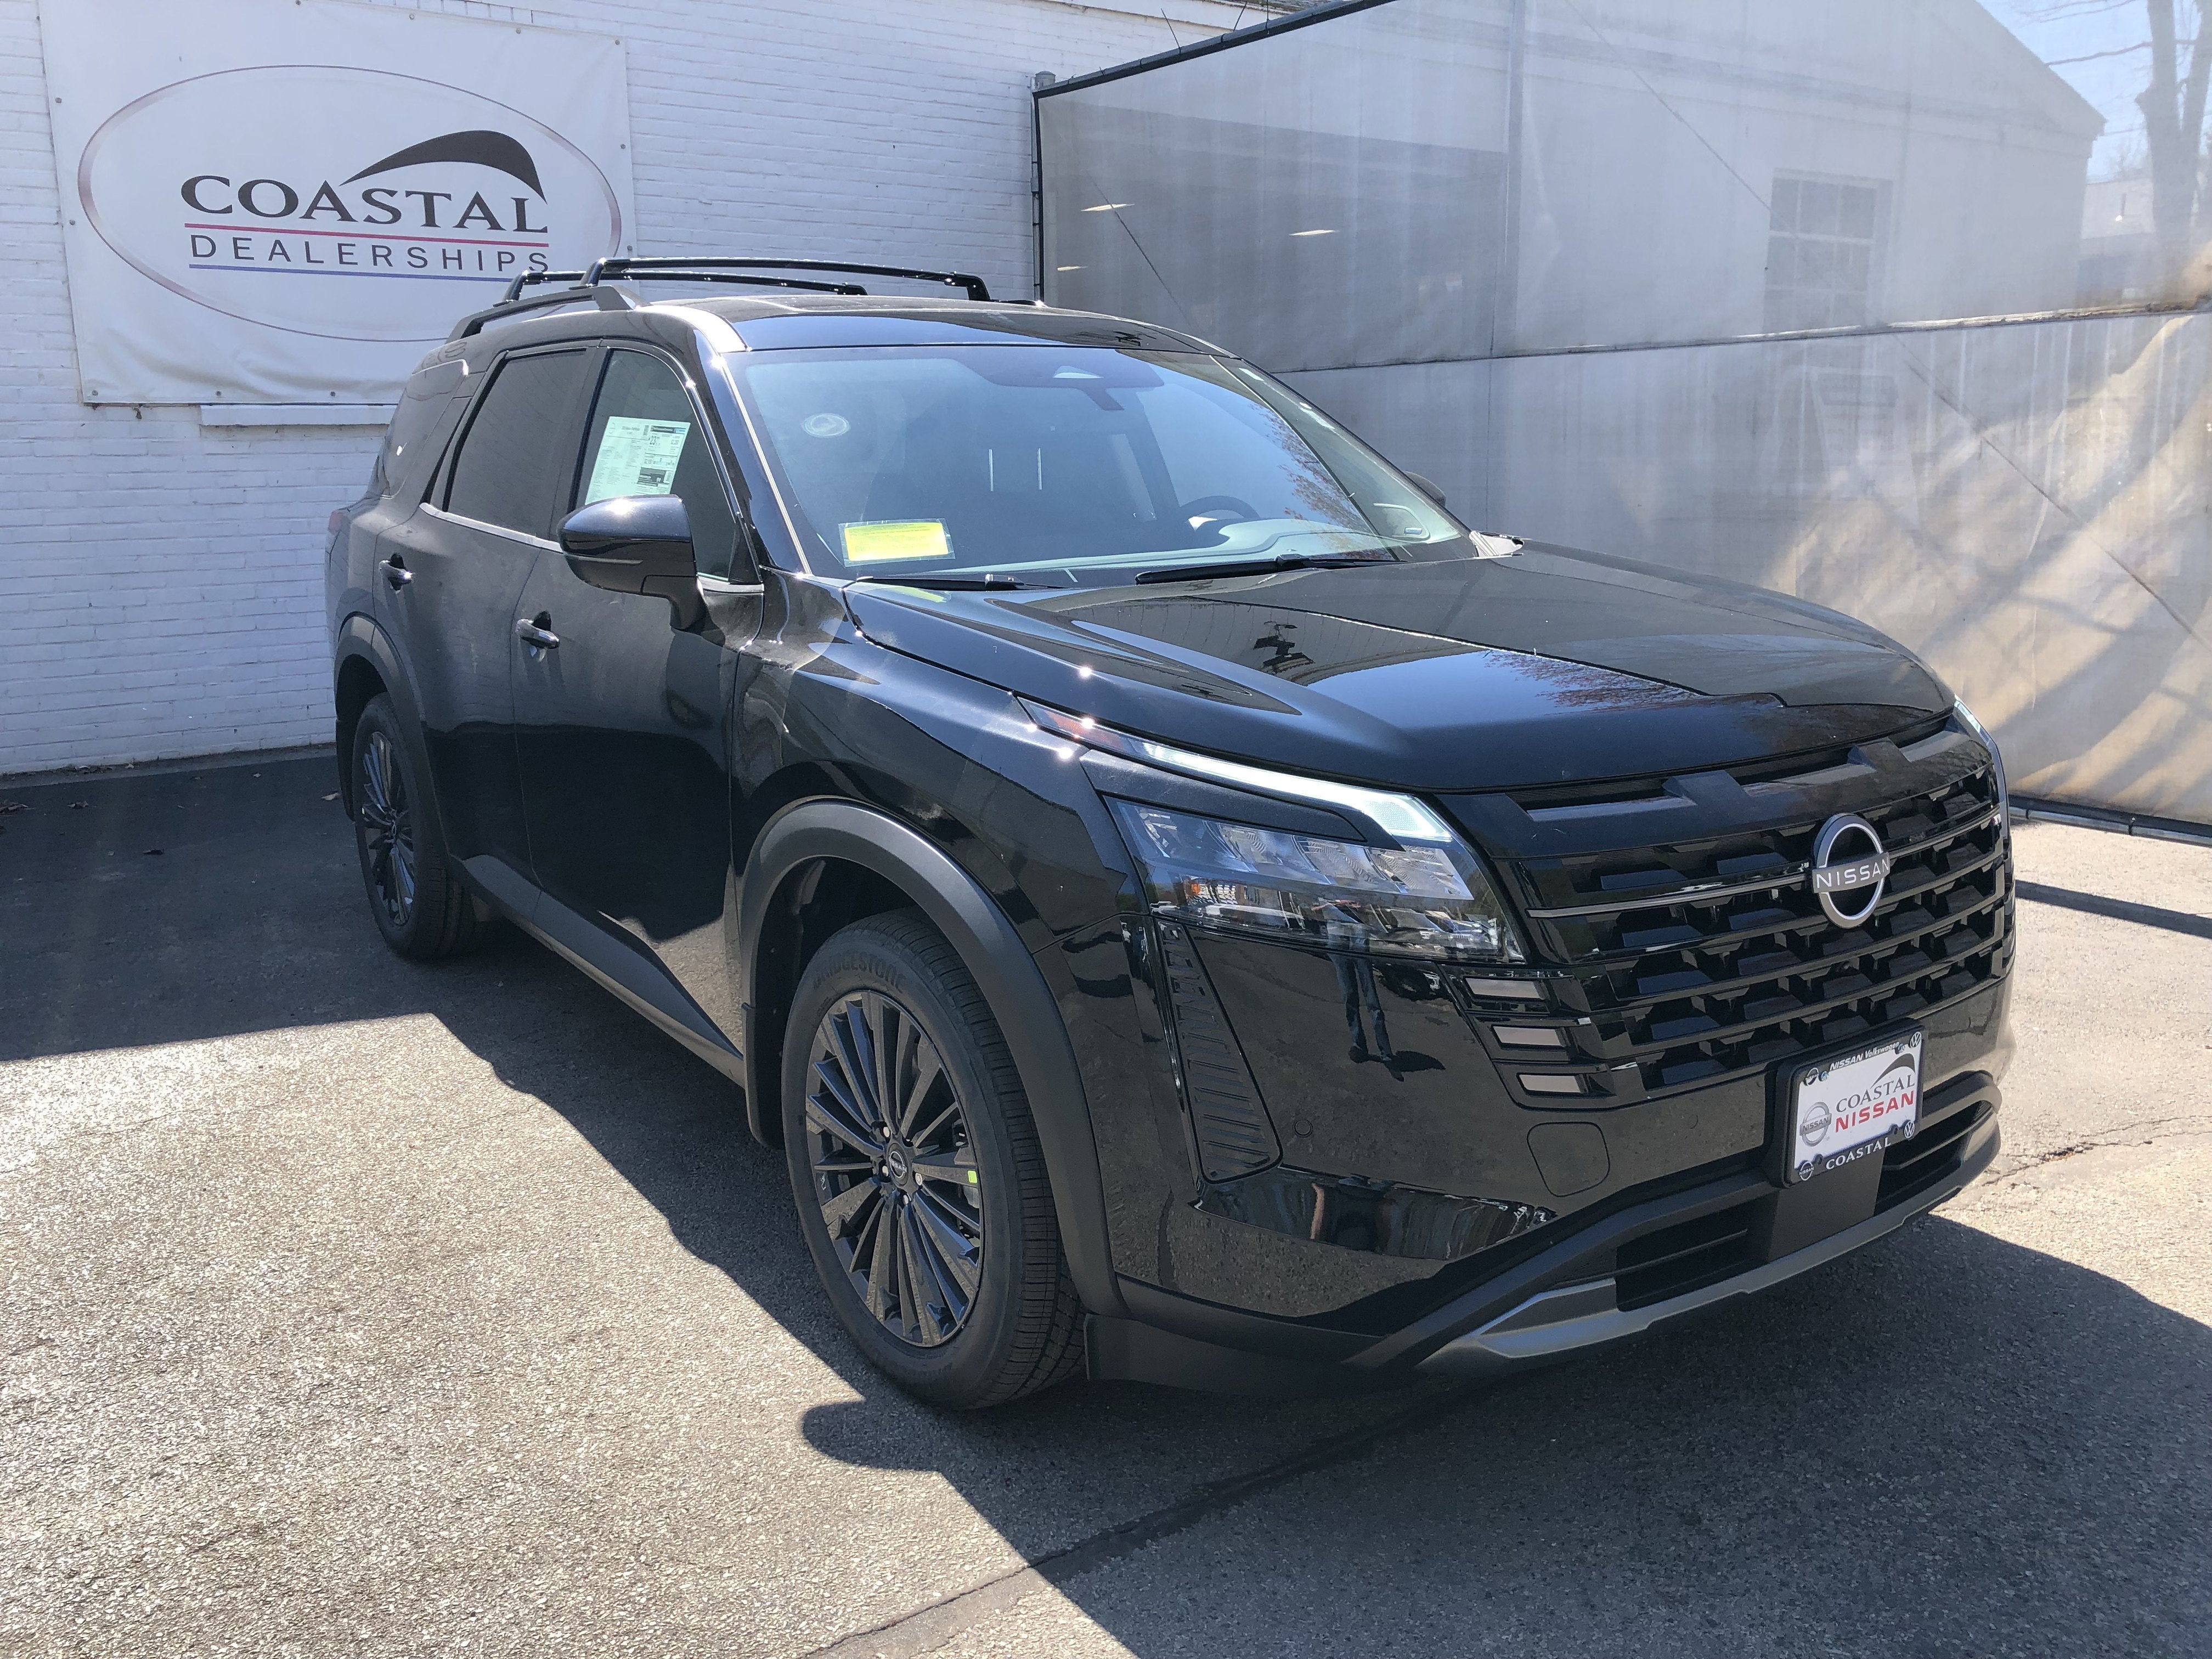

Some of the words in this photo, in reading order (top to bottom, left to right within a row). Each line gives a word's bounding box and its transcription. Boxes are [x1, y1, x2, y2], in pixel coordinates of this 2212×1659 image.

[180, 174, 548, 234] COASTAL
[190, 234, 549, 273] DEALERSHIPS
[1816, 856, 1889, 889] NISSAN
[1829, 1053, 1864, 1071] NISSAN
[1865, 1041, 1900, 1059] Volkswagen
[1836, 1074, 1915, 1113] COASTAL
[1802, 1116, 1829, 1132] NISSAN
[1835, 1090, 1915, 1133] NISSAN
[889, 1157, 907, 1172] SSAN
[1825, 1137, 1892, 1170] COASTAL
